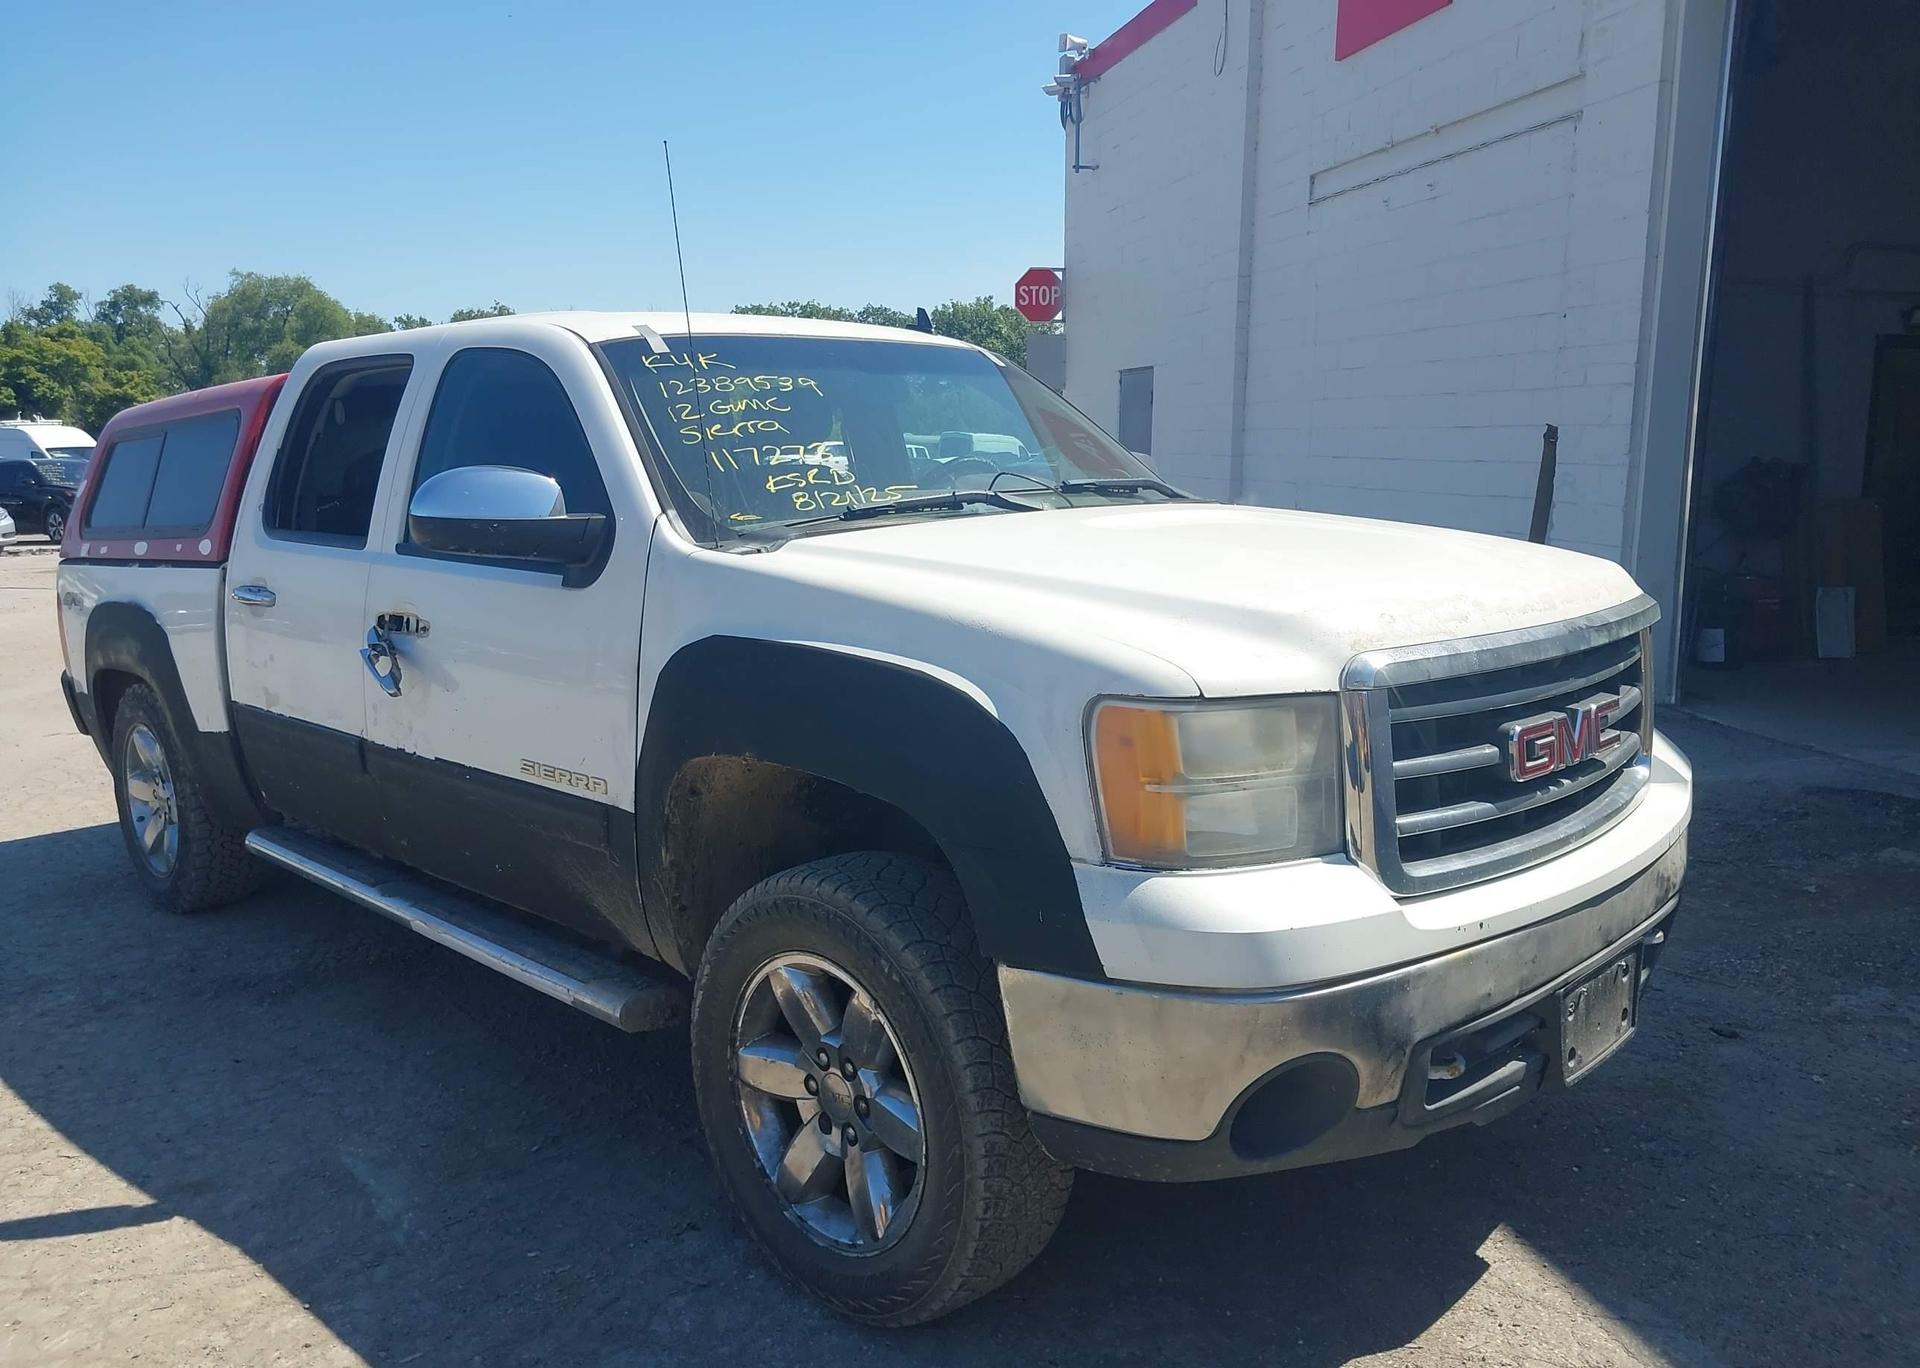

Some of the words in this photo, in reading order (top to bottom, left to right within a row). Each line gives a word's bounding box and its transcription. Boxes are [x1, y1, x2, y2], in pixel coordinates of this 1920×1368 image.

[1019, 285, 1060, 306] STOP
[659, 375, 824, 399] 12389539
[668, 403, 705, 422] 12
[679, 420, 791, 445] Sierra
[1506, 693, 1621, 783] GMC
[520, 758, 608, 795] SIERRA
